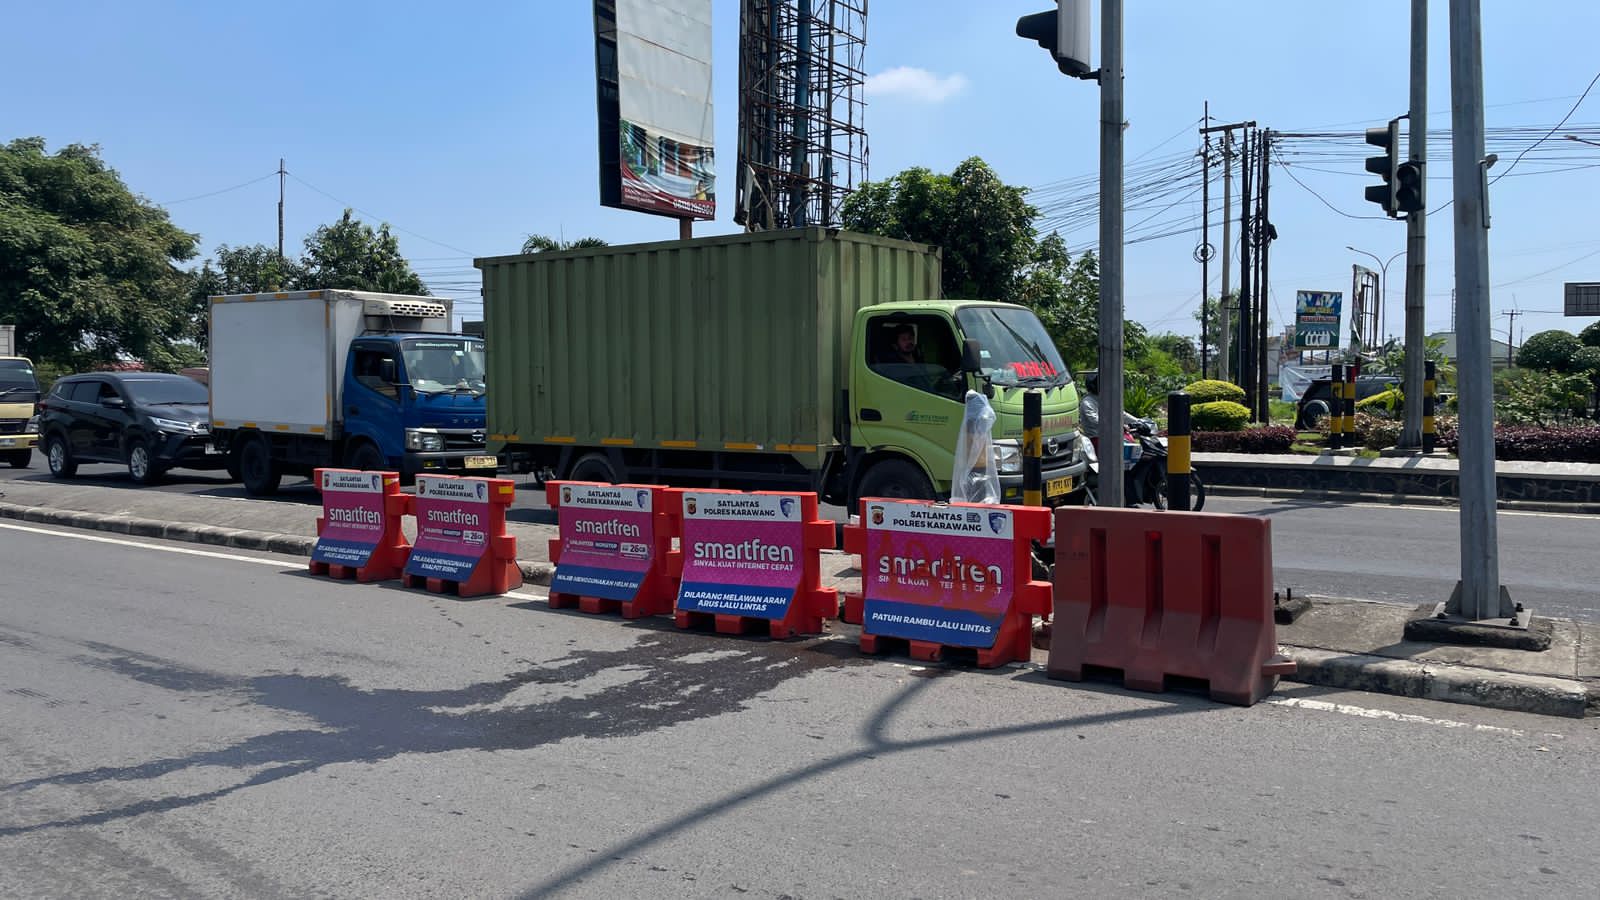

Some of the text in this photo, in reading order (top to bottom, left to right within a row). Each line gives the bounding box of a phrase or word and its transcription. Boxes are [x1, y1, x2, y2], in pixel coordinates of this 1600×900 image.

[576, 497, 633, 507] POLRES KARAWANG
[717, 500, 760, 508] SATLANTAS
[329, 506, 381, 524] smartfren
[427, 508, 479, 526] smartfren
[731, 509, 775, 517] KARAWANG
[910, 510, 962, 521] SATLANTAS
[575, 519, 640, 537] smartfren
[893, 518, 982, 532] POLRES KARAWANG
[694, 539, 794, 562] smartfren
[736, 562, 770, 570] INTERNET
[771, 563, 794, 571] CEPAT
[684, 591, 786, 605] DILARANG MELAWAN ARAH
[698, 600, 720, 608] ARUS
[740, 602, 767, 611] LINTAS
[871, 612, 992, 634] PATUHI RAMBU LALU LINTAS
